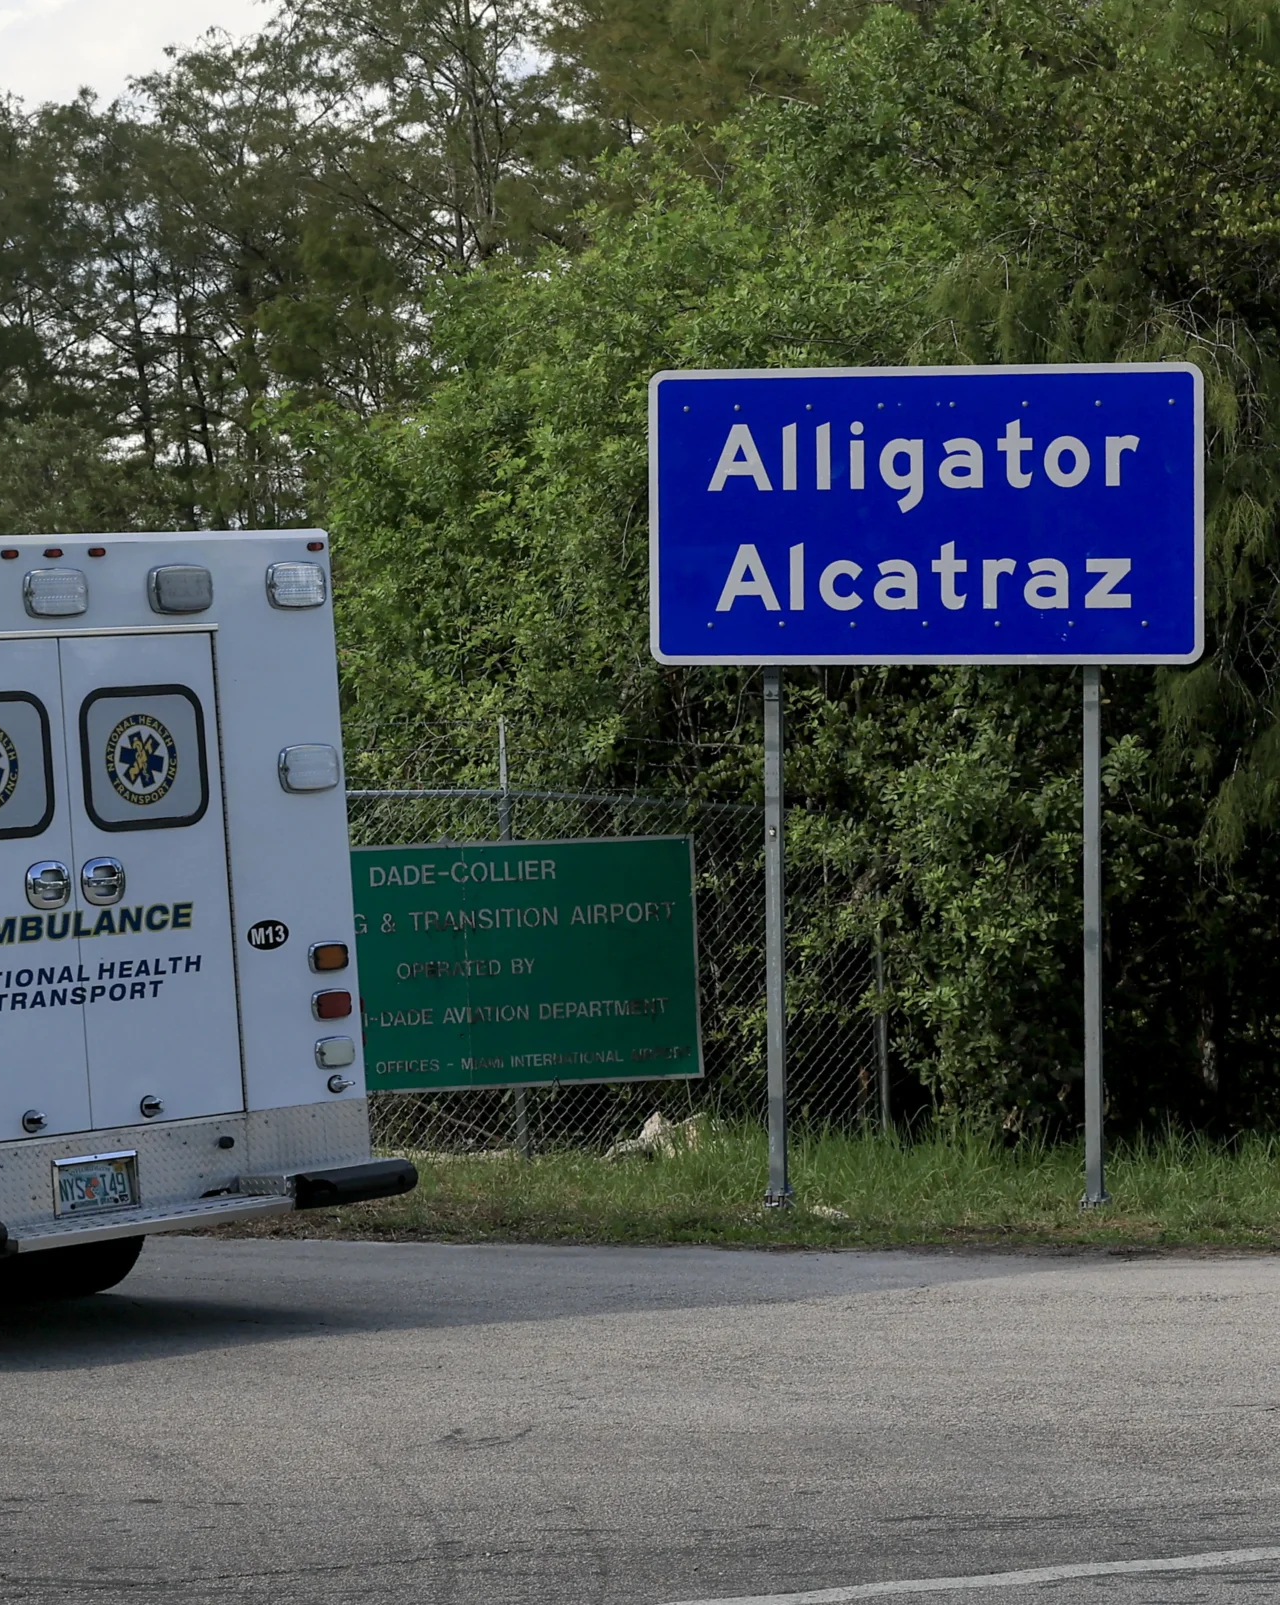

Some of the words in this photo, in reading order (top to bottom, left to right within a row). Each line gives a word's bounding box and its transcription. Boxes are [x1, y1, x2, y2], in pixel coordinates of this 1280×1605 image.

[707, 418, 1140, 513] Alligator
[715, 540, 1131, 612] Alcatraz
[107, 717, 136, 772] NATIONAL
[139, 715, 173, 747] HEALTH
[5, 769, 18, 795] INC.
[113, 778, 169, 804] TRANSPORT
[167, 753, 177, 780] INC.
[369, 859, 557, 888] DADE-COLLIER
[381, 913, 396, 933] &
[409, 907, 558, 933] TRANSITION
[570, 901, 676, 926] AIRPORT
[250, 926, 285, 946] M13
[97, 955, 202, 981] HEALTH
[397, 959, 502, 980] OPERATED
[511, 958, 535, 975] BY
[442, 1004, 529, 1026] AVIATION
[539, 997, 669, 1021] DEPARTMENT
[376, 1058, 440, 1075] OFFICES
[461, 1055, 504, 1071] MIAMI
[511, 1049, 624, 1068] INTERNATIONAL
